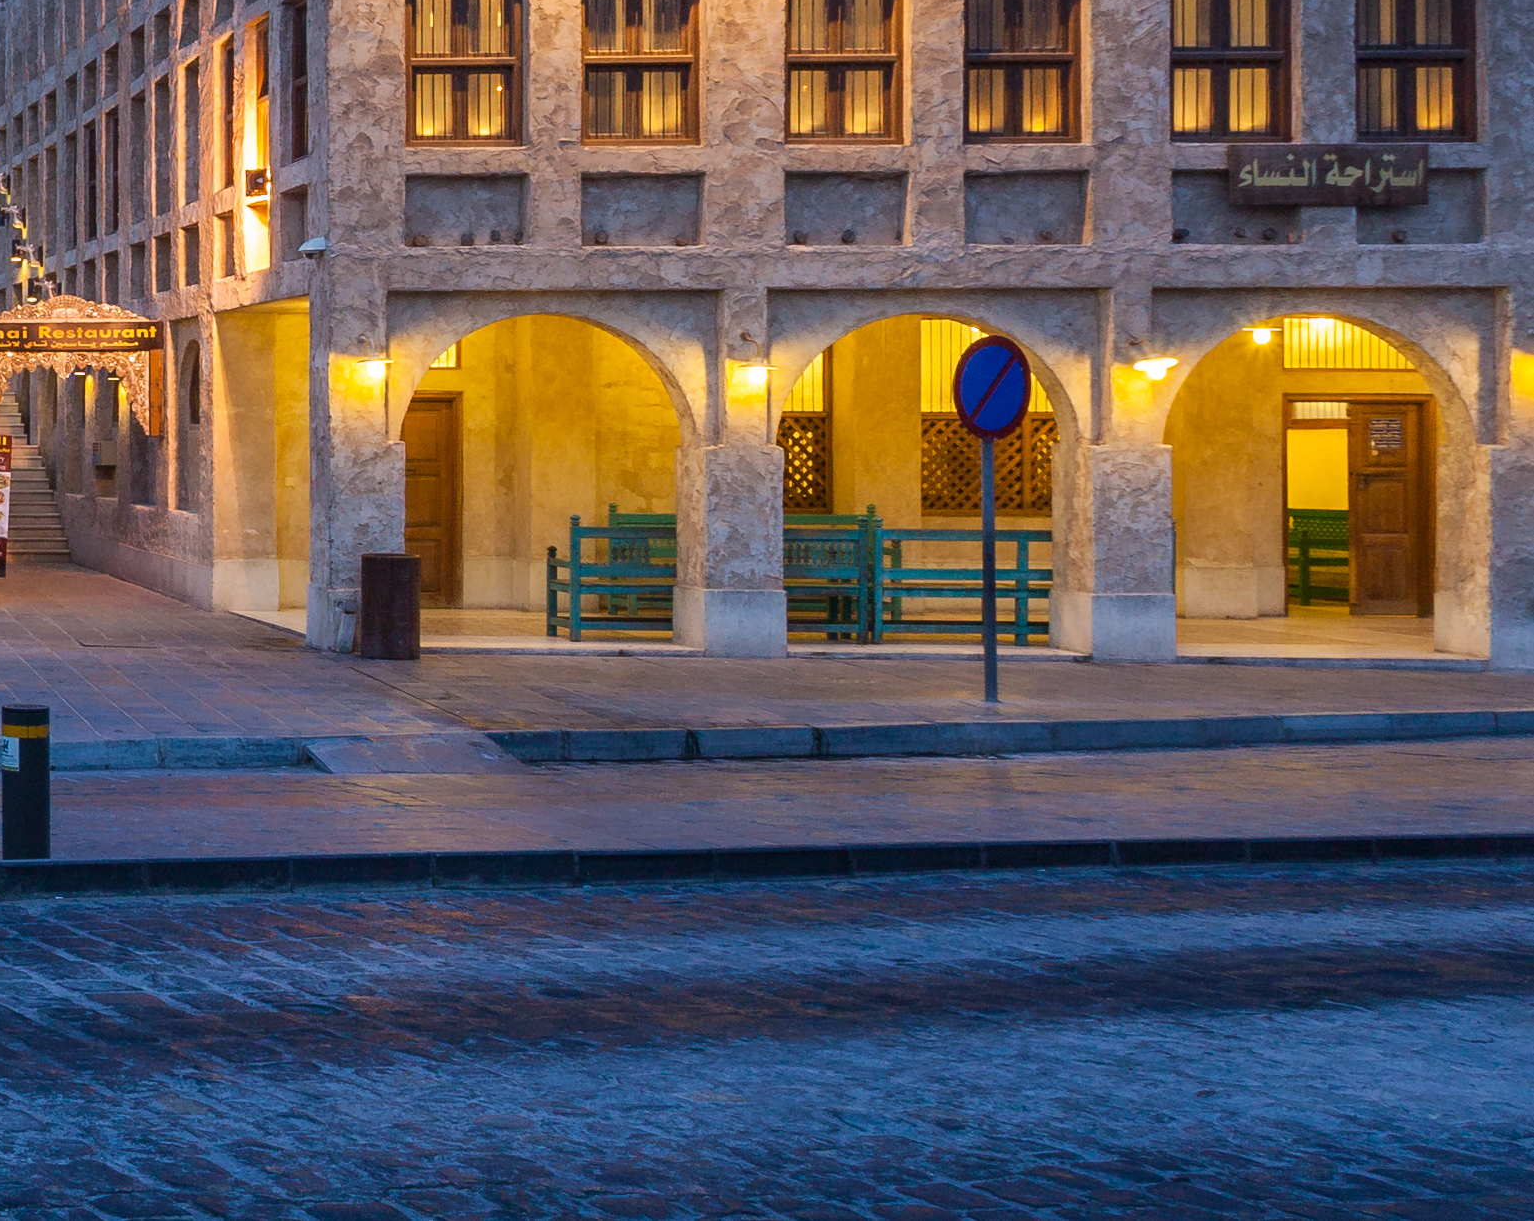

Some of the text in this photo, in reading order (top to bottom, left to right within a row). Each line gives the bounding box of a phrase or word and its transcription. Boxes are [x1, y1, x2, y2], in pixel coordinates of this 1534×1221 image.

[1238, 153, 1425, 193] استراحة النساء
[38, 325, 157, 339] Restaurant
